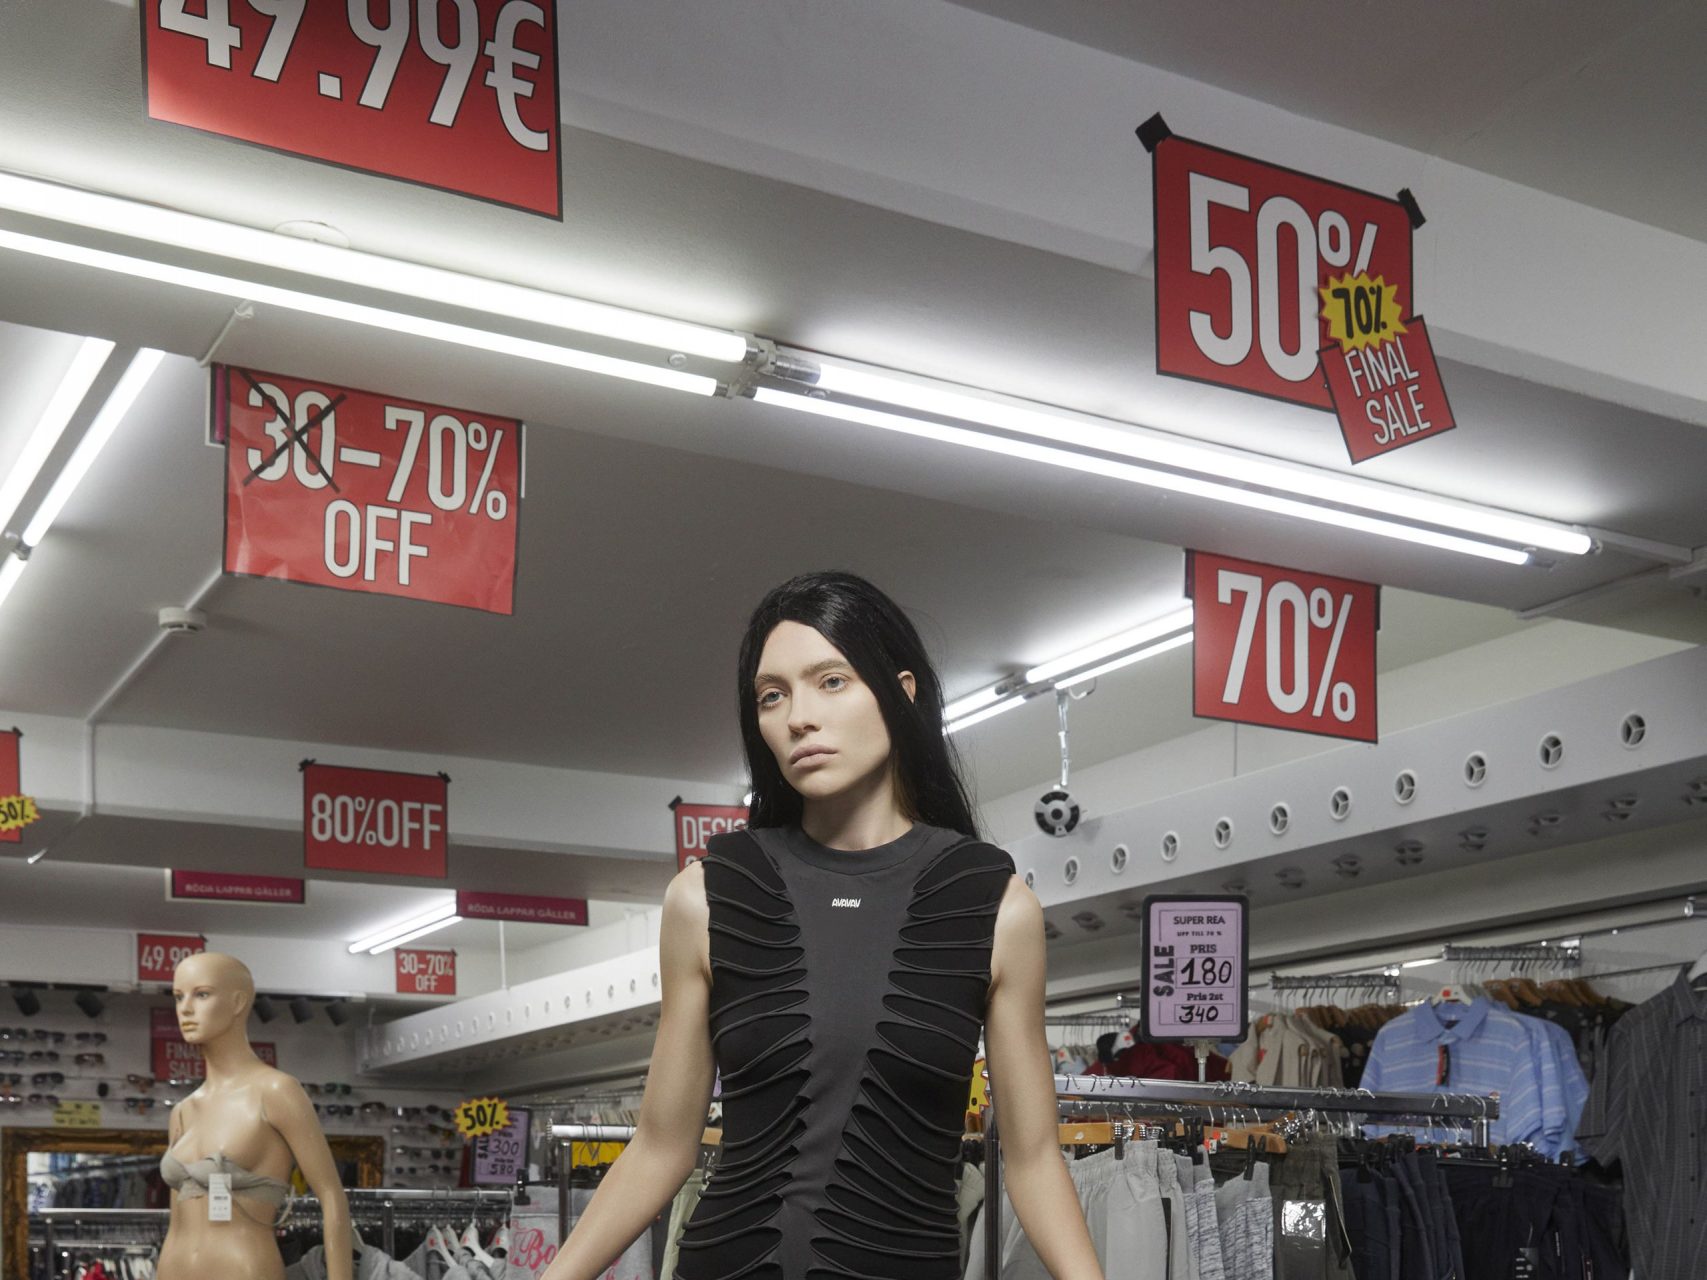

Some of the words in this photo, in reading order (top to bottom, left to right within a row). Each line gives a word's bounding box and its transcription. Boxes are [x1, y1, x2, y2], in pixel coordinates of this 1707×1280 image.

[1331, 284, 1388, 339] 70%
[1345, 335, 1419, 397] FINAL
[1365, 384, 1431, 445] SALE
[323, 499, 433, 586] OFF
[1217, 568, 1356, 723] 70%
[1173, 915, 1204, 925] SUPER
[1206, 915, 1226, 925] REA
[1189, 944, 1217, 954] PRIS
[415, 974, 438, 992] OFF
[1153, 945, 1174, 997] SALE
[1180, 957, 1232, 986] 180
[1186, 993, 1207, 1001] Pris
[1178, 1005, 1219, 1024] 340
[462, 1102, 500, 1131] 50%
[491, 1139, 519, 1156] 300
